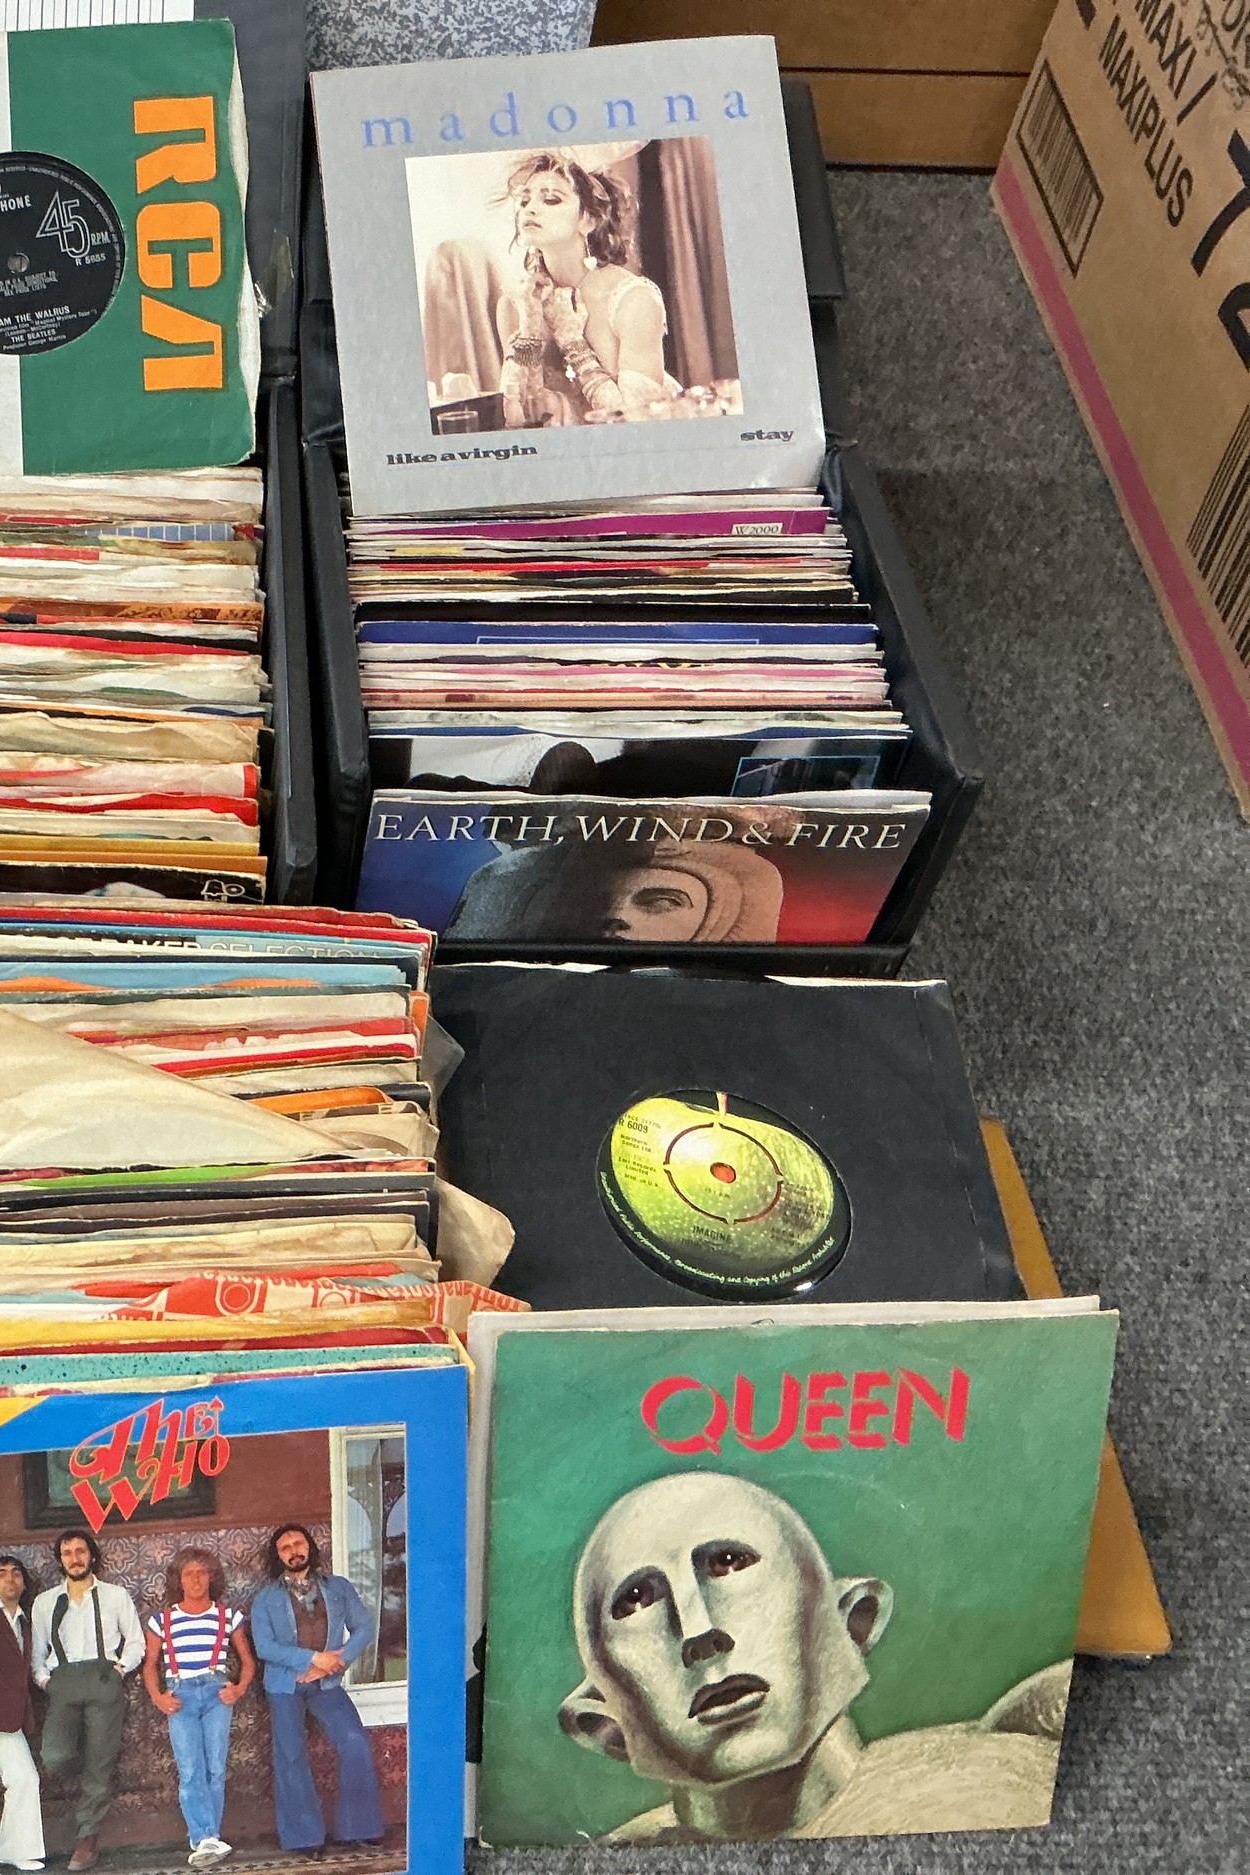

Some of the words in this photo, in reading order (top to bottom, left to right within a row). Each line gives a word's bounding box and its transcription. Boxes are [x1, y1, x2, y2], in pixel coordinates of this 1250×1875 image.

[361, 89, 750, 148] madonna
[1098, 13, 1193, 227] MAXIPLUS
[36, 190, 90, 259] 45
[133, 96, 223, 391] RCA
[75, 257, 82, 266] R
[85, 253, 107, 264] 5655
[15, 313, 32, 323] THE
[34, 305, 70, 319] WALRUS
[27, 329, 56, 340] BEATLES
[740, 427, 794, 443] stay
[386, 453, 438, 465] like
[749, 525, 779, 535] 2000
[374, 814, 567, 847] EARTH,
[575, 815, 734, 845] WIND
[742, 822, 775, 845] &
[790, 822, 907, 851] FIRE
[618, 1118, 624, 1126] R
[627, 1120, 648, 1133] 6009
[693, 1226, 732, 1243] IMAGINE
[641, 1366, 971, 1456] QUEEN
